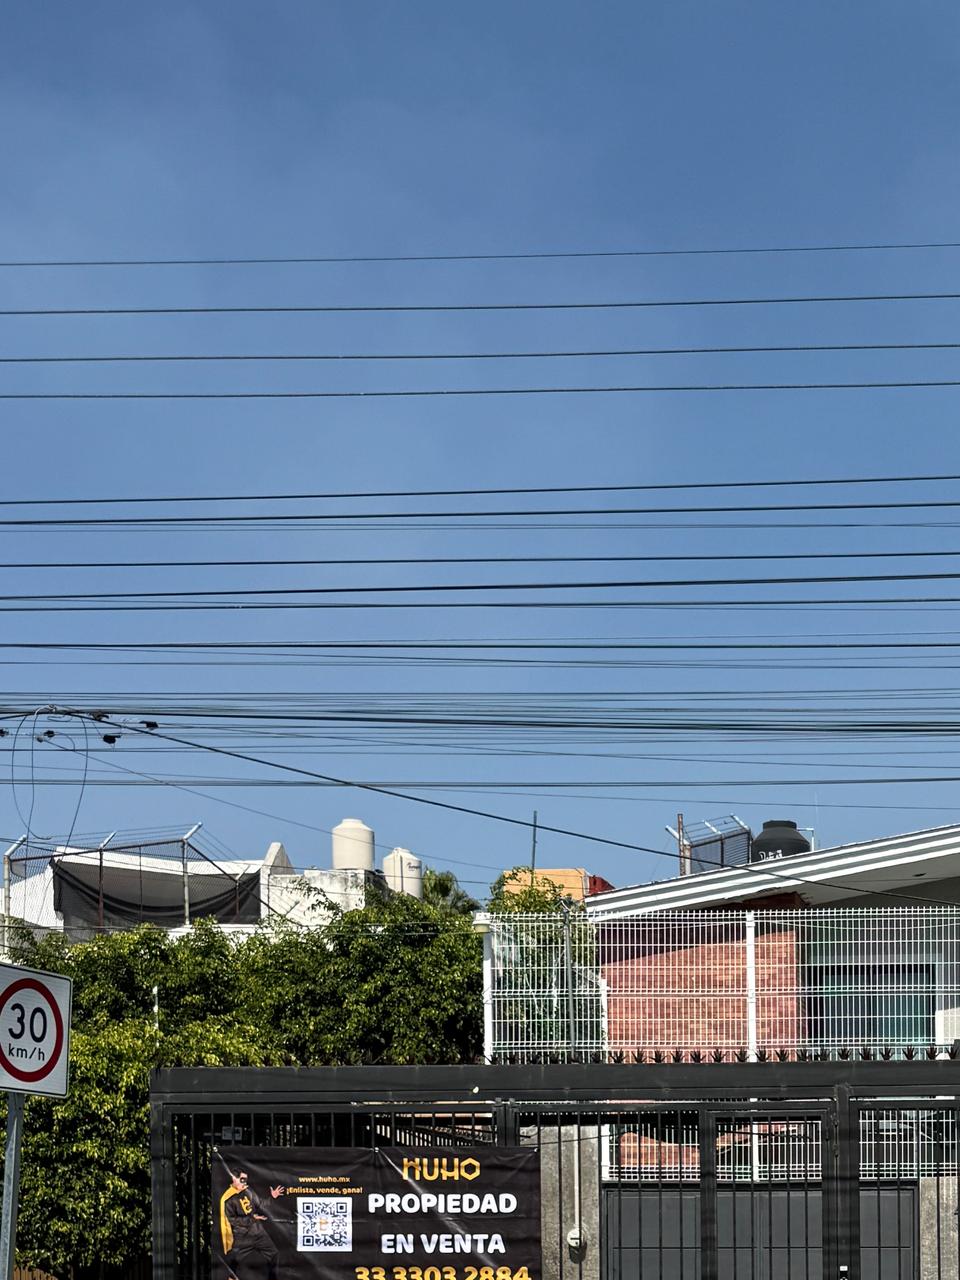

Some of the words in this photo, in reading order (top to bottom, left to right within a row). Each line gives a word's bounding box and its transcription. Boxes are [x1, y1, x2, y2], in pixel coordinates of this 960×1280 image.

[8, 1003, 47, 1043] 30
[8, 1043, 46, 1061] km/h
[401, 1157, 480, 1181] HUHO
[368, 1193, 517, 1214] PROPIEDAD
[381, 1234, 414, 1254] EN
[419, 1233, 506, 1254] VENTA
